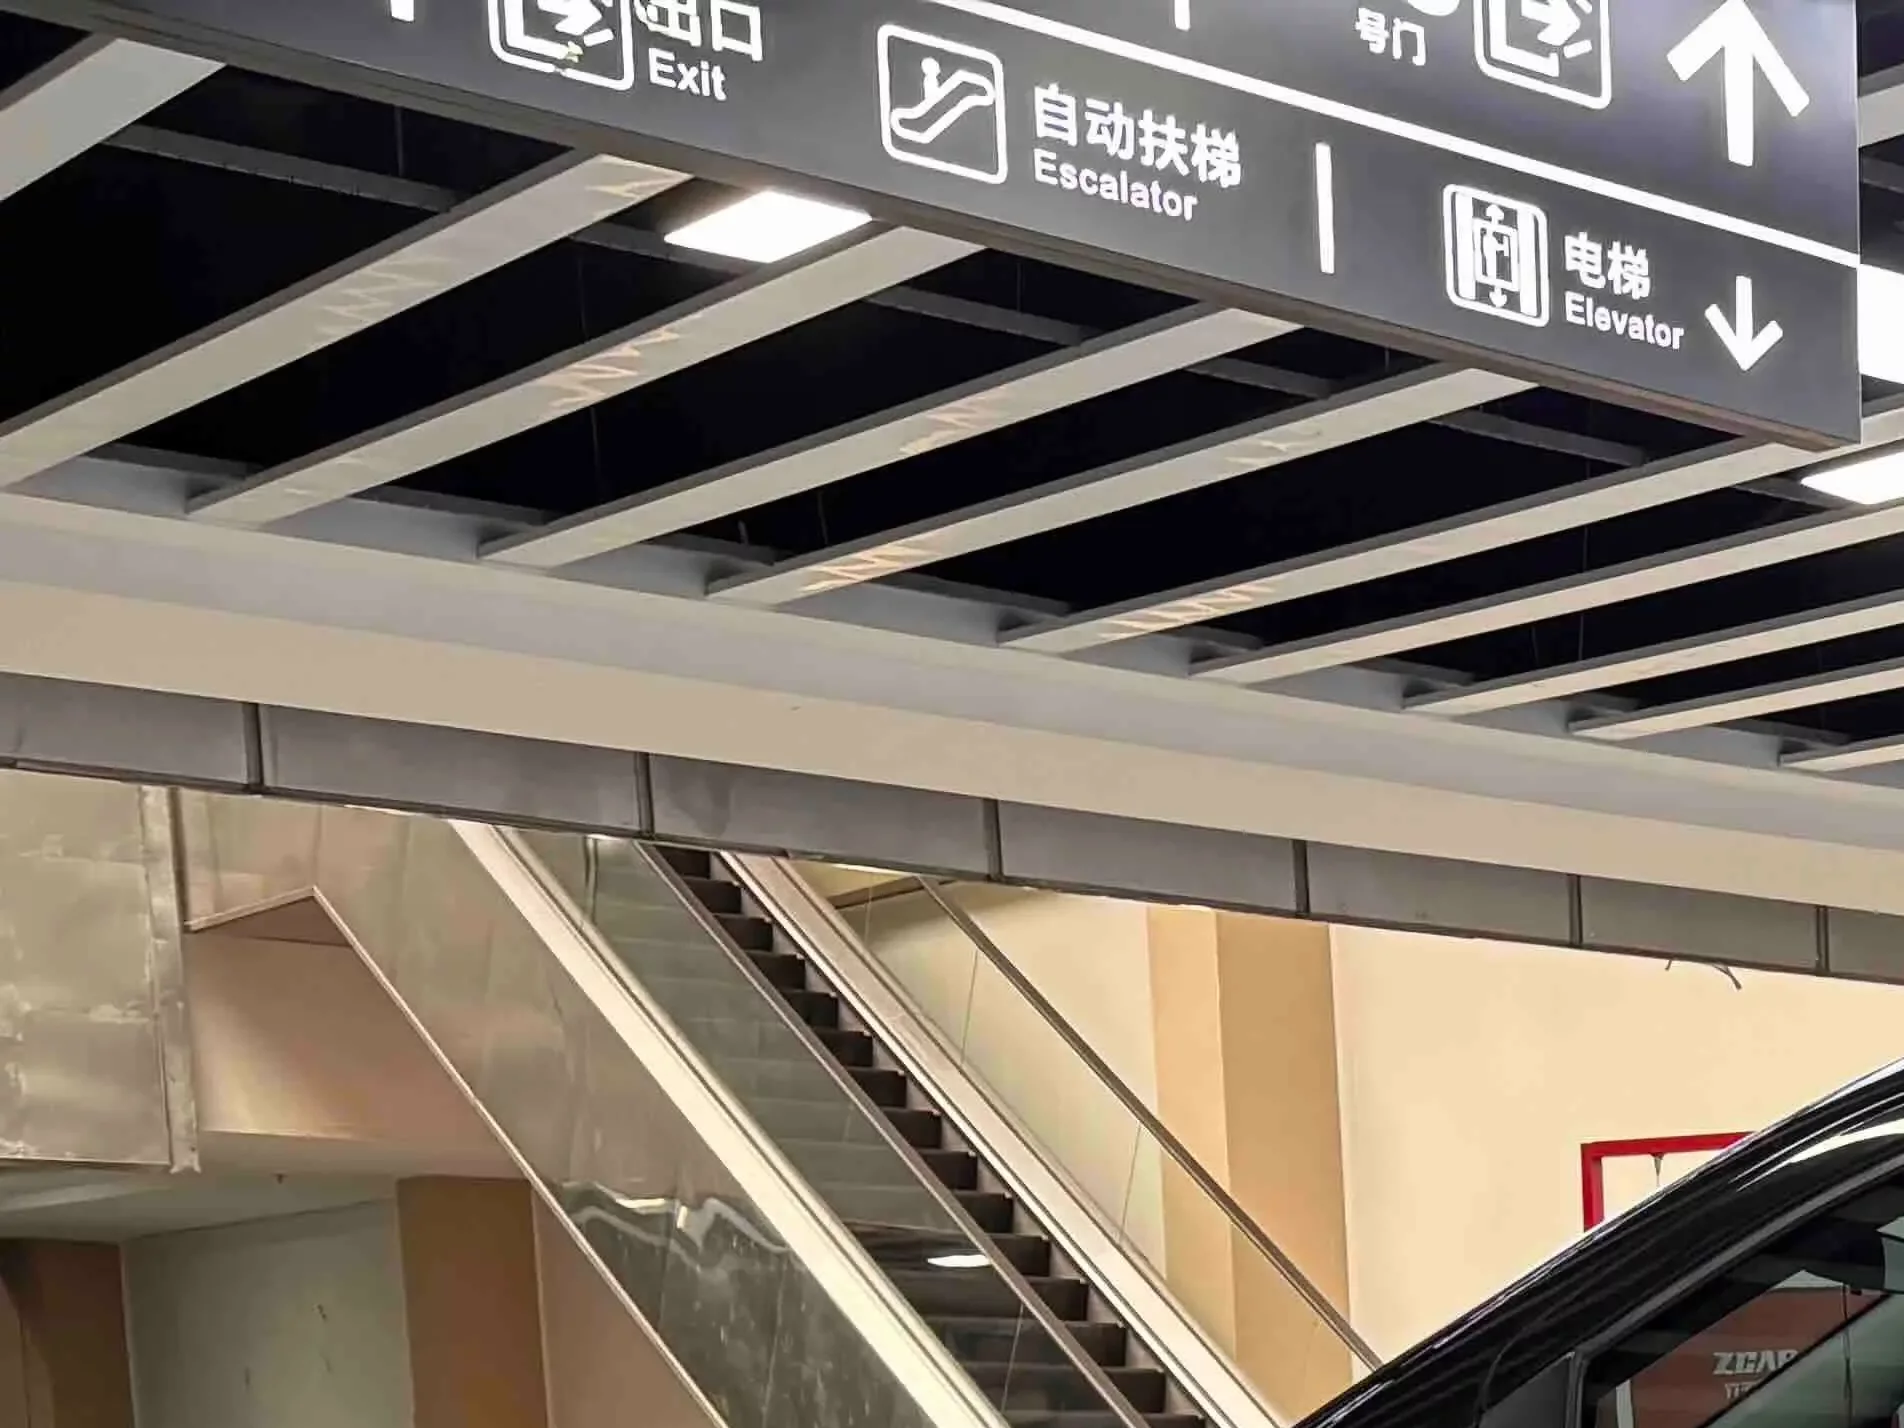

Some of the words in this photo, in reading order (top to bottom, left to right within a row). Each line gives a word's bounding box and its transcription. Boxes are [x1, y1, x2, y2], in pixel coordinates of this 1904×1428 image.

[1355, 7, 1427, 66] 号门
[649, 47, 727, 101] Exit
[1034, 83, 1241, 188] 自动扶梯
[1034, 148, 1198, 221] Escalator
[1564, 231, 1651, 300] 电梯
[1564, 290, 1685, 350] Elevator
